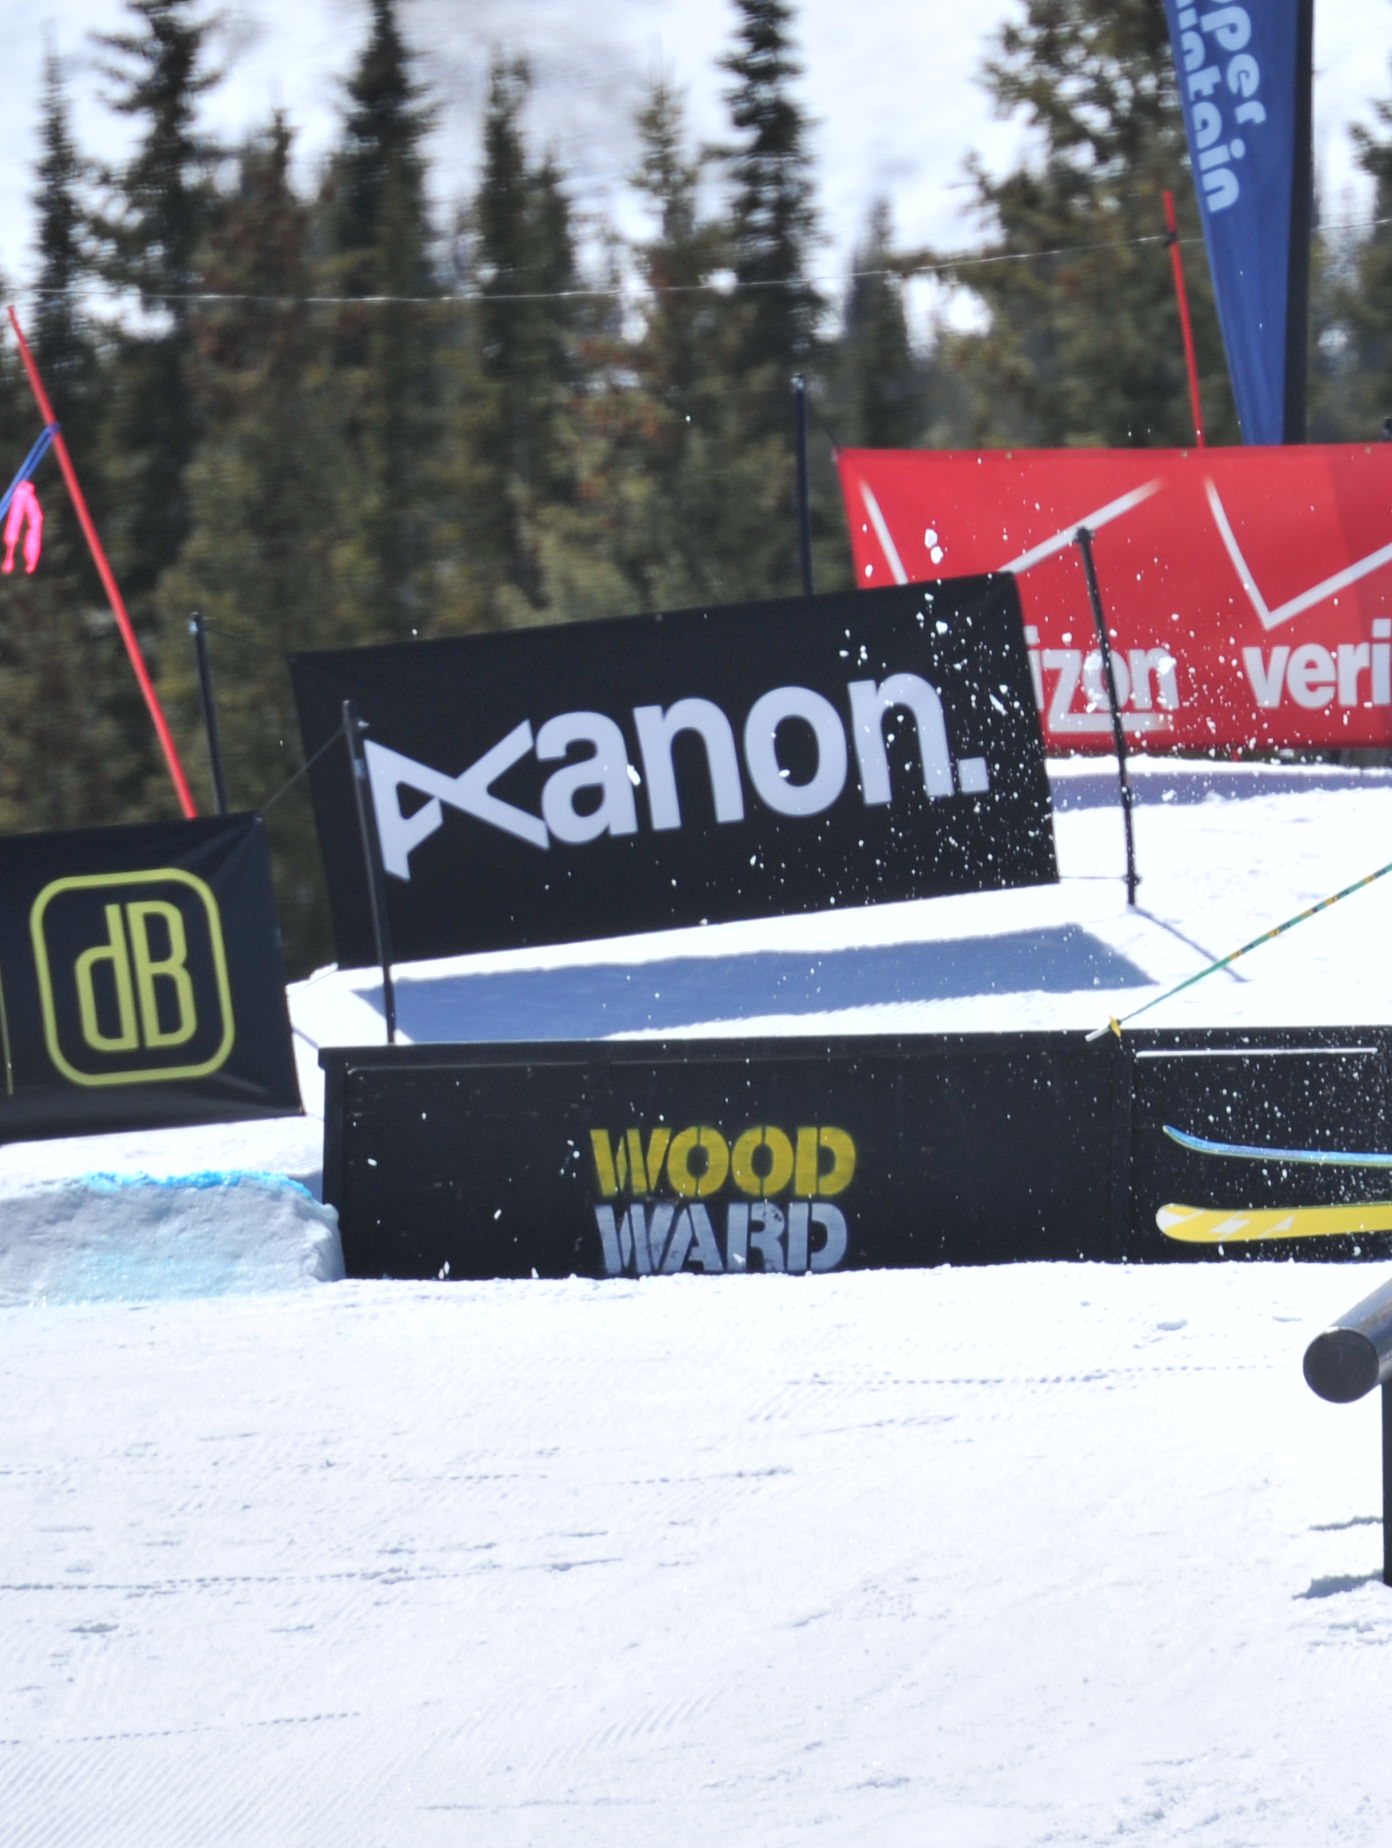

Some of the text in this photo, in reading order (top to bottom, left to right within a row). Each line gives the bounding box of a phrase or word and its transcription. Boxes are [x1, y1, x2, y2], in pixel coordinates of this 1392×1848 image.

[1201, 0, 1267, 124] per
[1024, 625, 1180, 732] izon
[74, 900, 197, 1053] dB
[590, 1126, 856, 1197] WOOD
[595, 1202, 848, 1274] WARD
